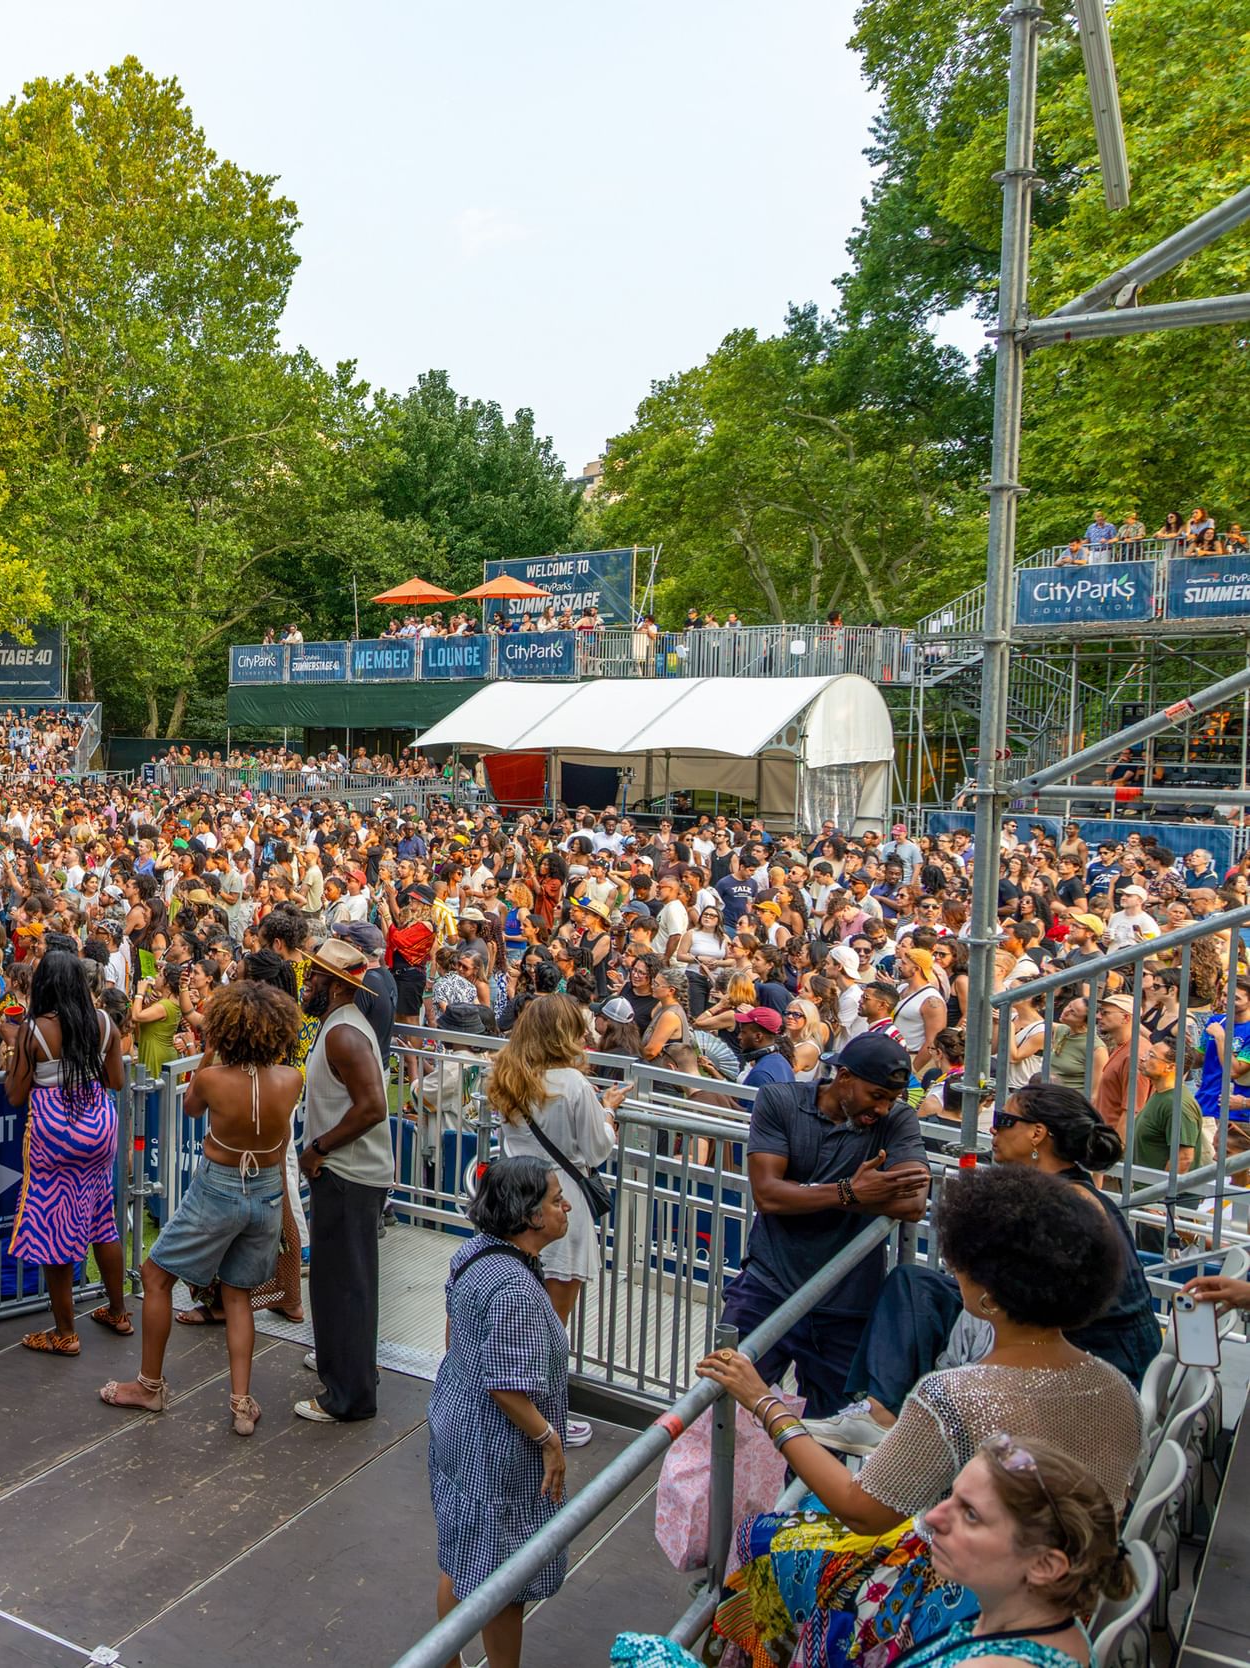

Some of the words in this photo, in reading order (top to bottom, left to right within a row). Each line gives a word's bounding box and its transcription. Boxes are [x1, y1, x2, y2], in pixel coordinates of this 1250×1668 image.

[526, 561, 574, 579] WELCOME
[577, 559, 590, 575] TO
[1033, 576, 1135, 604] CityParks
[508, 591, 601, 615] SUMMERSTAGE
[1032, 603, 1134, 615] FOUNDATION
[238, 653, 277, 668] CityParks
[355, 649, 410, 670] MEMBER
[428, 646, 481, 668] LOUNGE
[506, 642, 563, 662] CityParks
[732, 886, 753, 894] YALE
